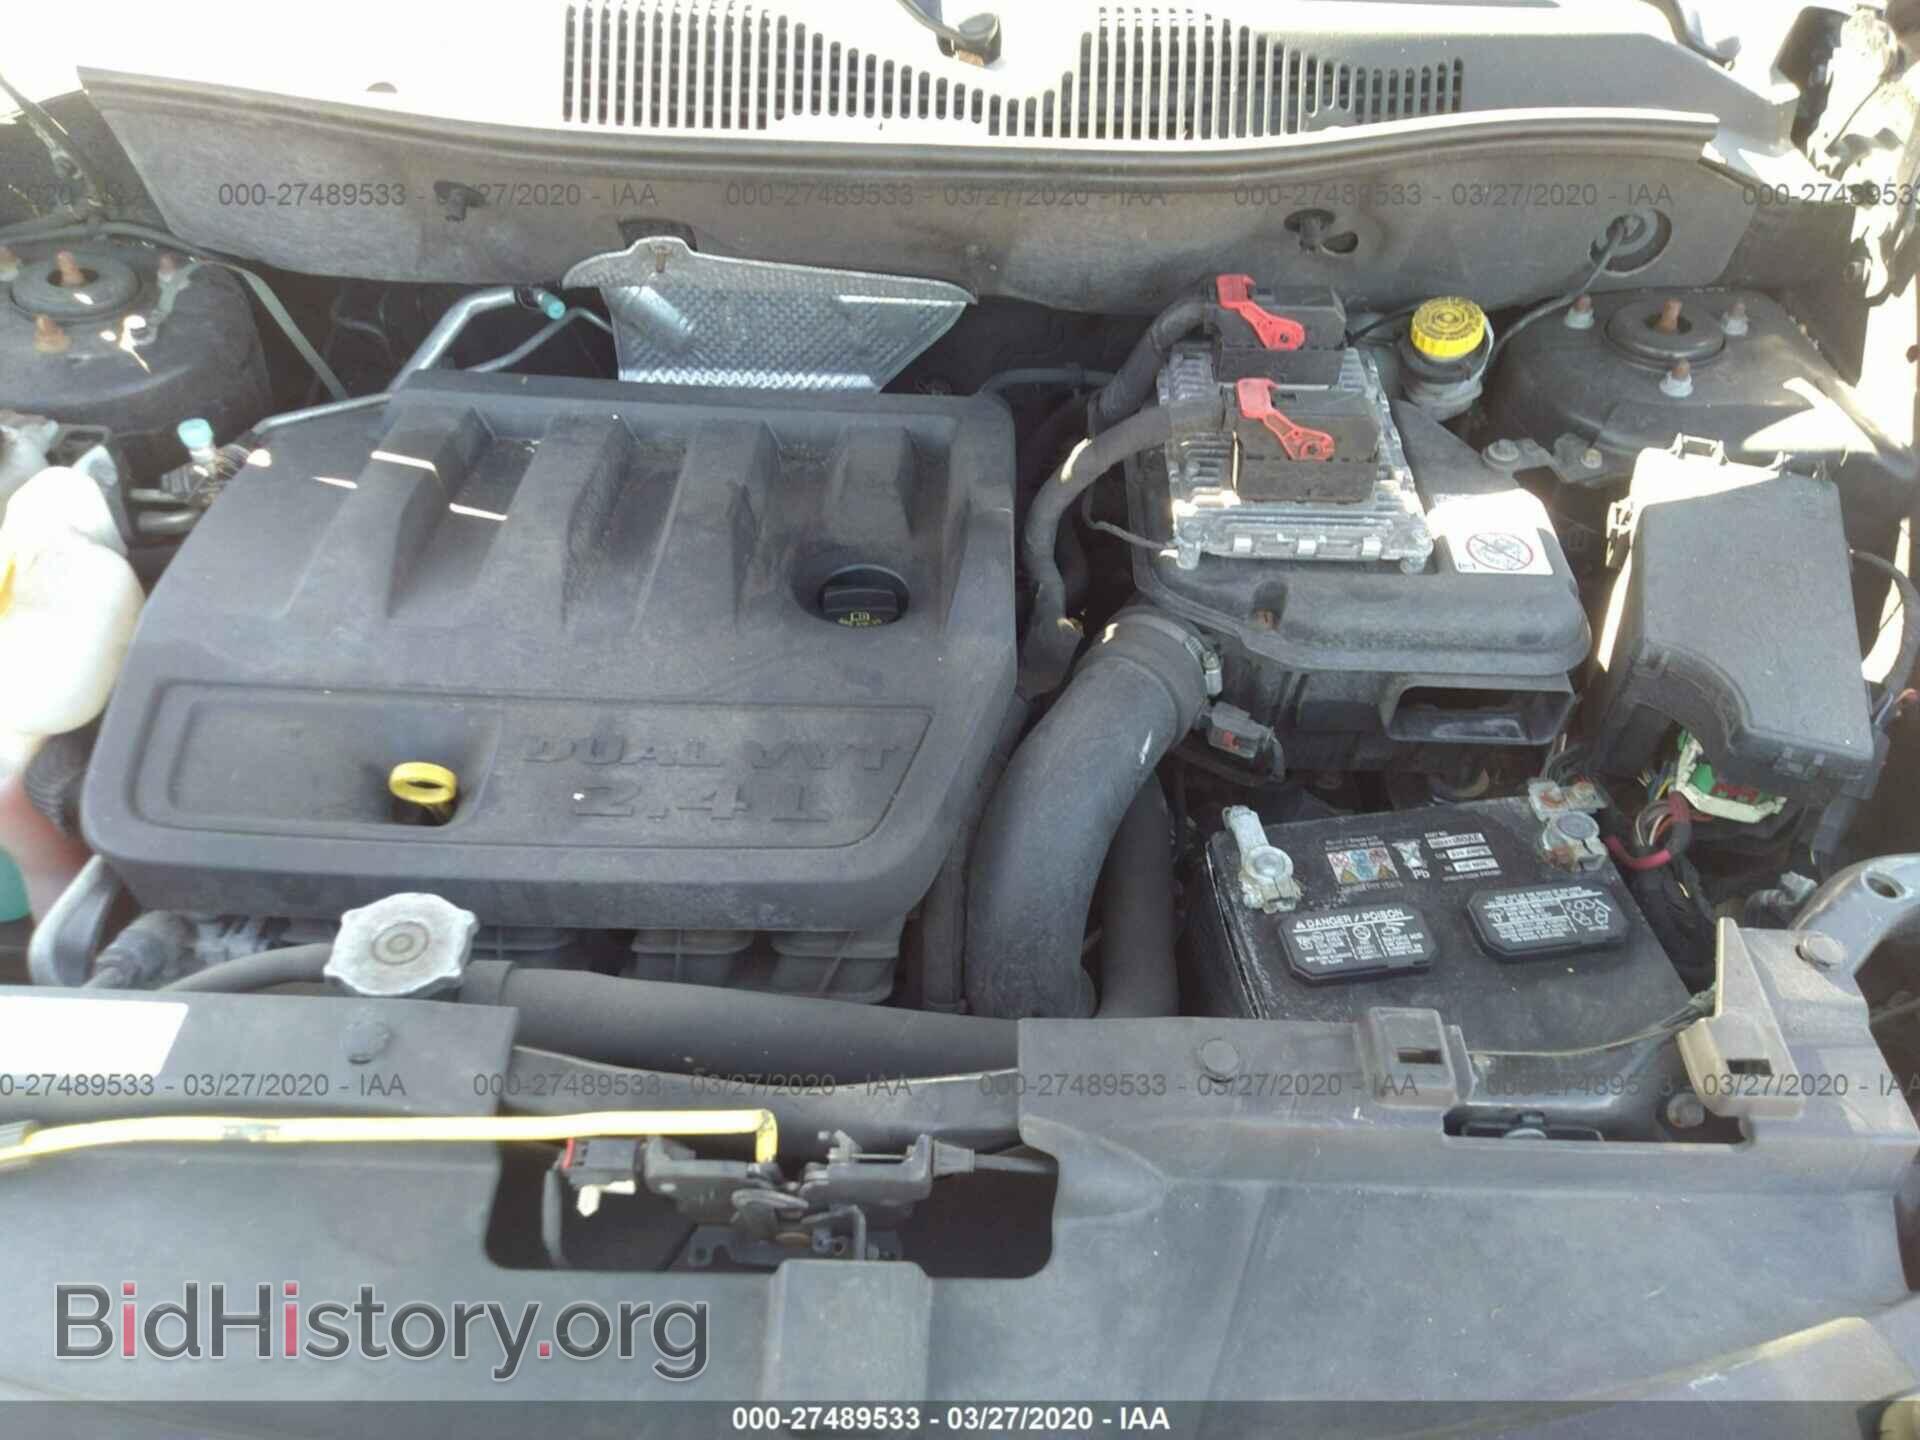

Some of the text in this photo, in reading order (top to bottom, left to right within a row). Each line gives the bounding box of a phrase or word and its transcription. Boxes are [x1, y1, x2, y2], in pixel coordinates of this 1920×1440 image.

[1412, 867, 1431, 880] Pb
[1307, 914, 1352, 930] DANGER
[1362, 907, 1405, 922] POISON
